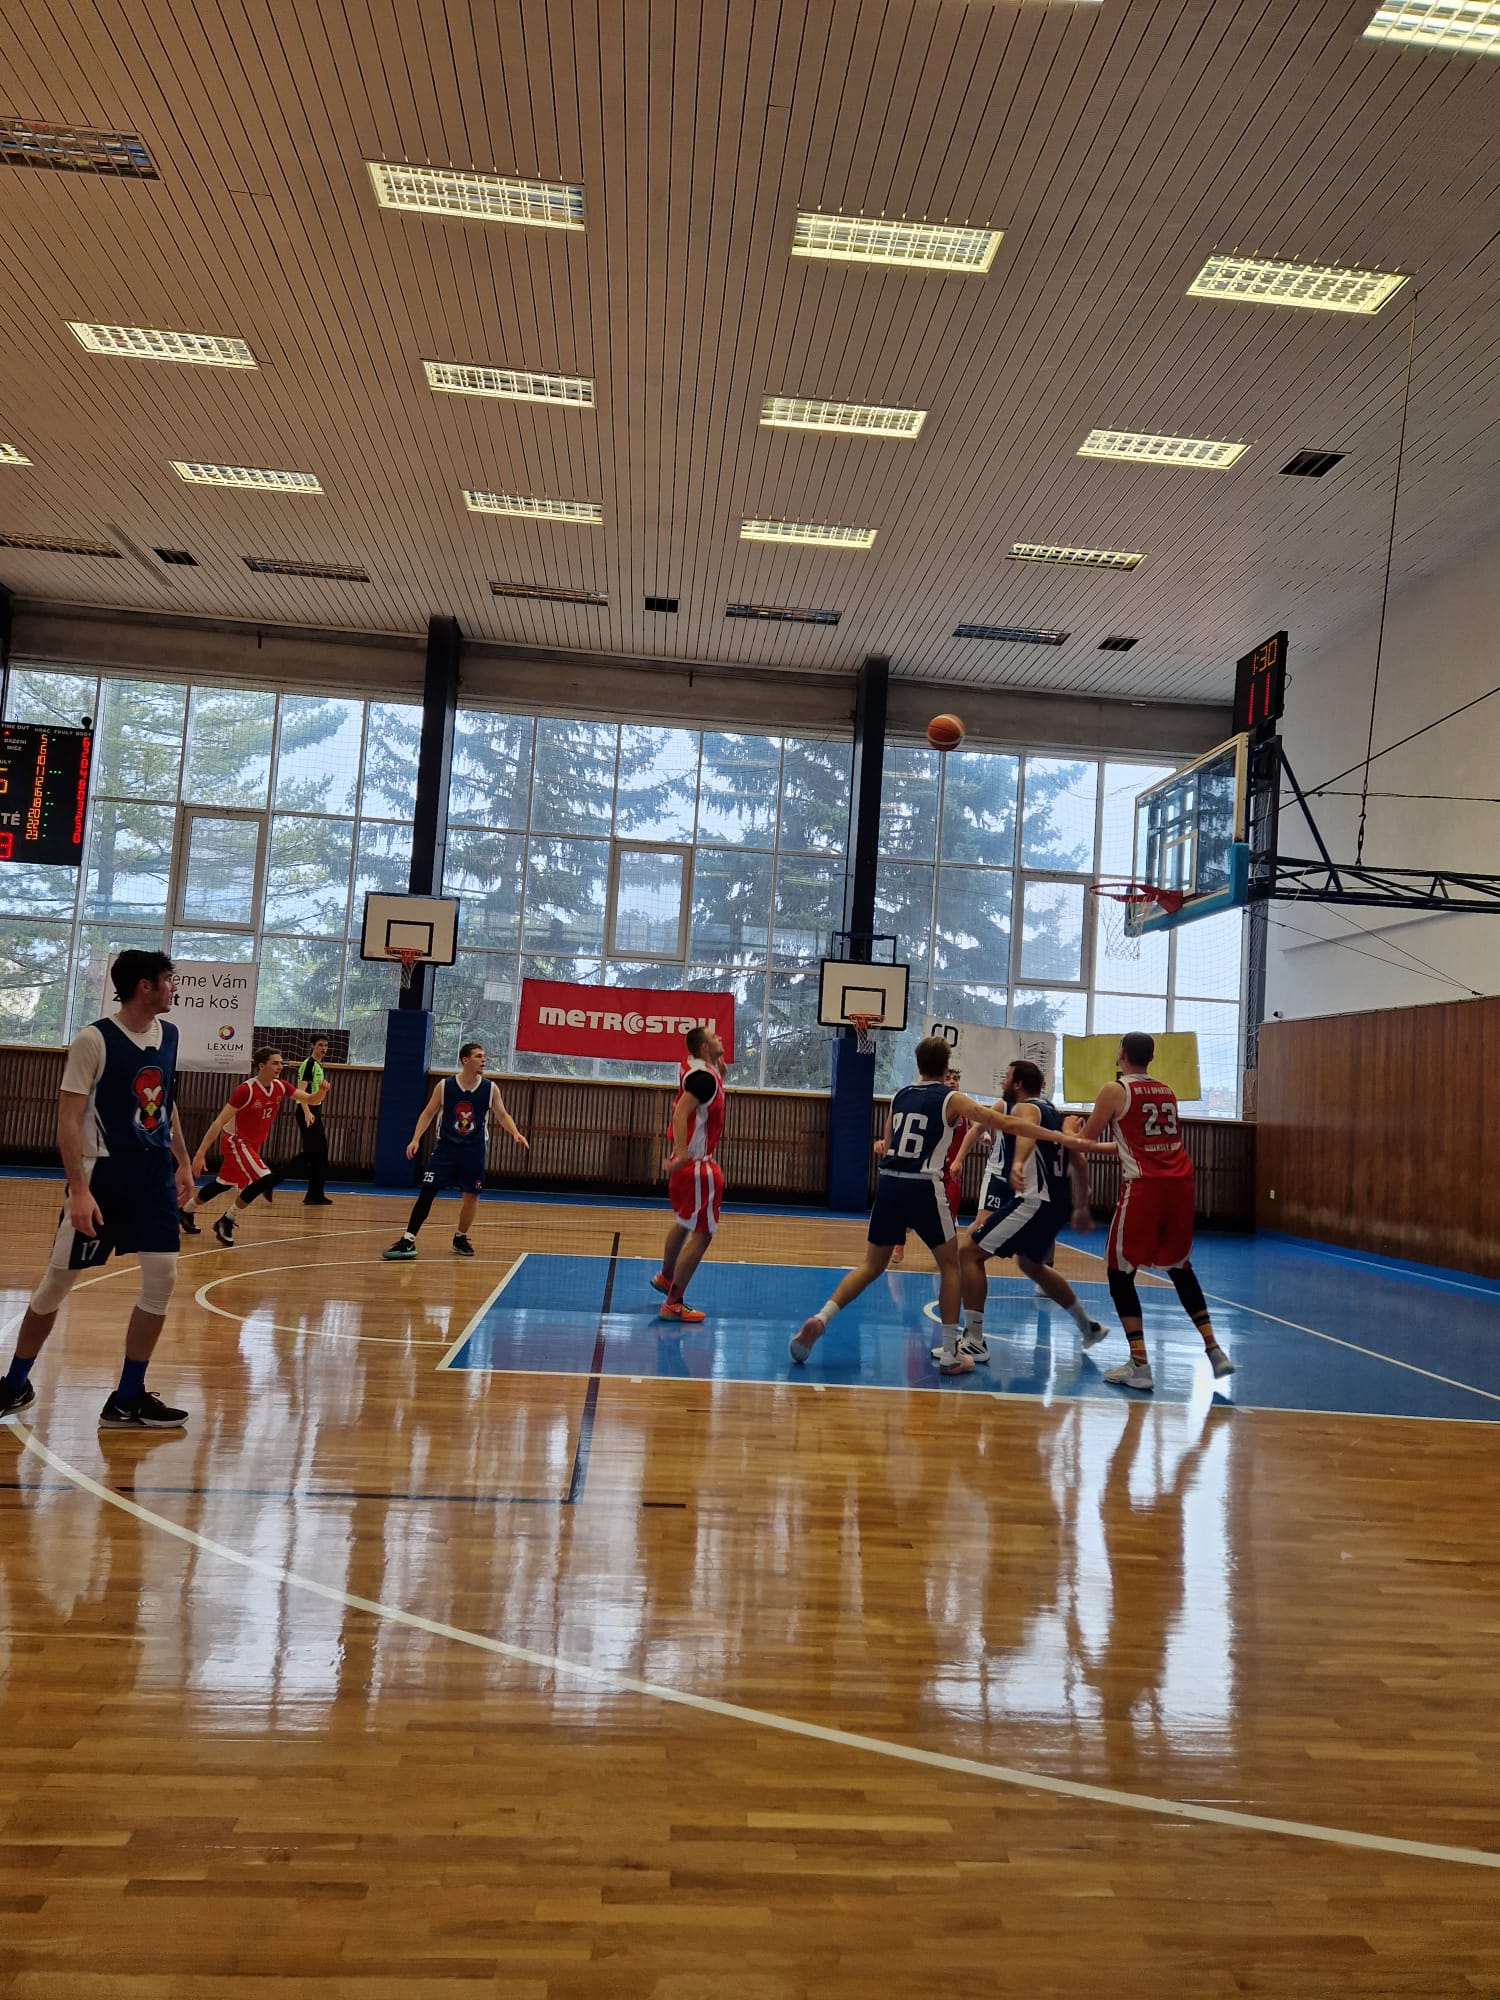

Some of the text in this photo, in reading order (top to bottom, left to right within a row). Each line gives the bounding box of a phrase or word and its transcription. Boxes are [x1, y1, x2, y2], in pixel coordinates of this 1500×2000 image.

[1250, 639, 1278, 676] 1:30
[1247, 672, 1271, 726] 11
[42, 734, 47, 744] 5
[40, 745, 46, 754] 6
[37, 755, 46, 765] 10
[36, 766, 45, 775] 11
[34, 788, 42, 797] 16
[28, 808, 40, 818] 20
[27, 819, 39, 829] 22
[172, 974, 247, 989] eme Vám
[184, 996, 204, 1008] na
[209, 994, 239, 1010] koš
[207, 1043, 244, 1051] LEXUM
[262, 1108, 273, 1119] 12
[1142, 1102, 1178, 1136] 23
[423, 1171, 435, 1183] 25
[986, 1195, 1000, 1208] 29
[81, 1240, 100, 1261] 17
